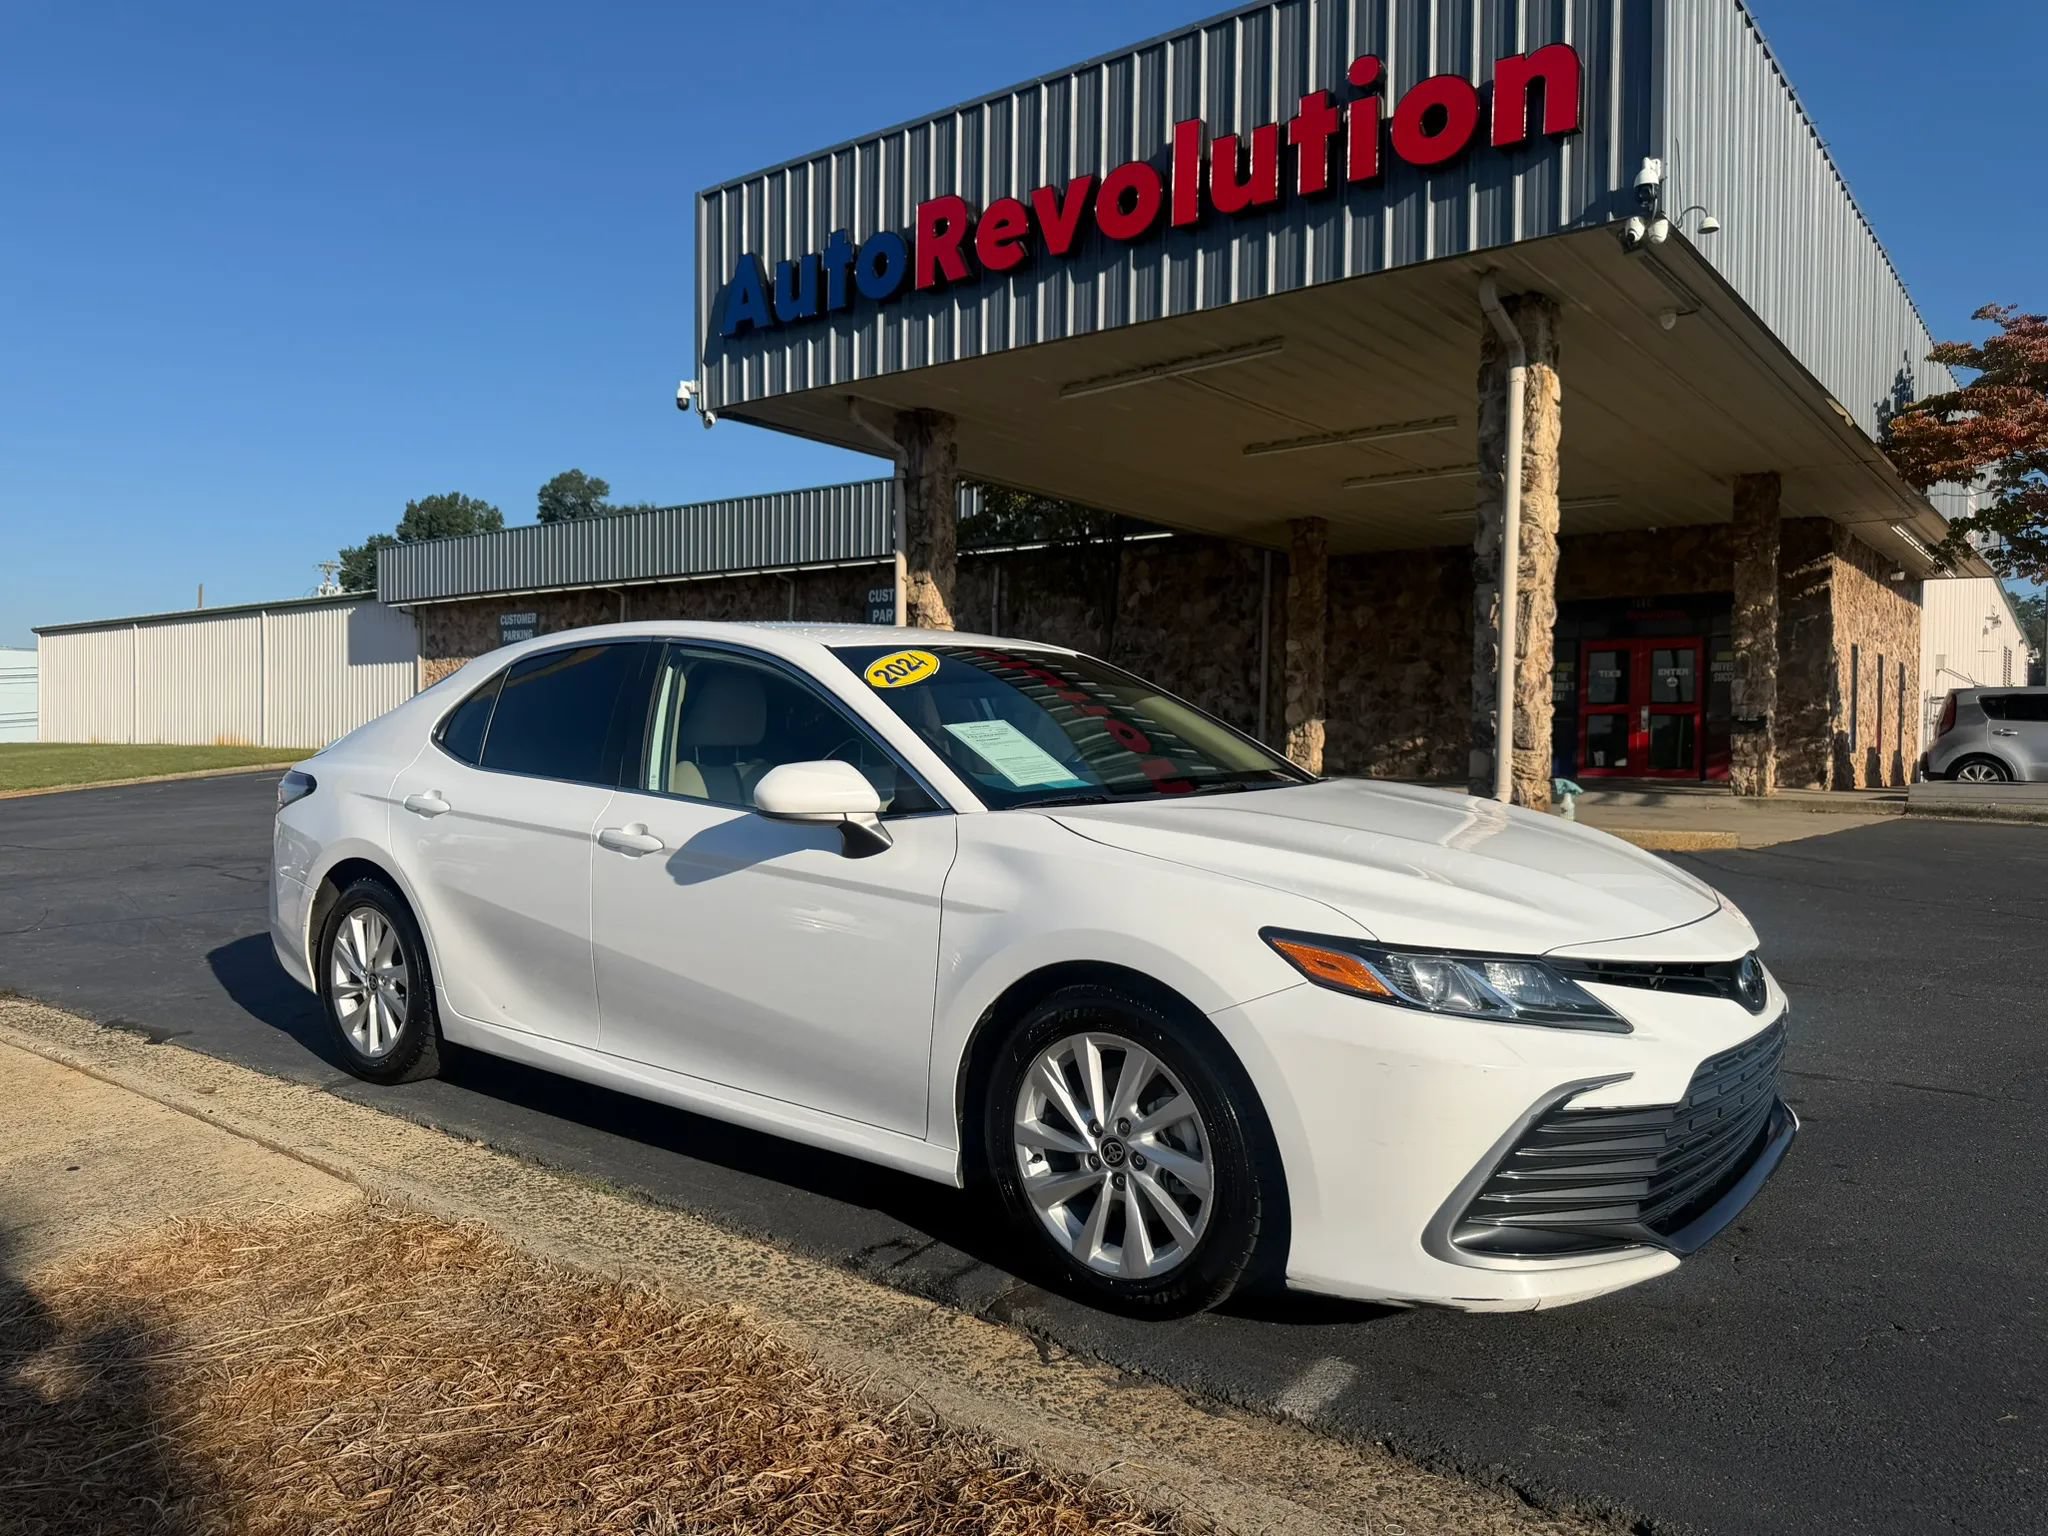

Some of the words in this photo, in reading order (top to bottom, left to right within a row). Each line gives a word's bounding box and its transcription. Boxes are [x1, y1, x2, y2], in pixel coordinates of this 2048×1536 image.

[500, 612, 537, 625] CUSTOMER
[503, 629, 534, 642] PARKING
[873, 652, 929, 684] 2024
[1657, 667, 1689, 677] ENTER
